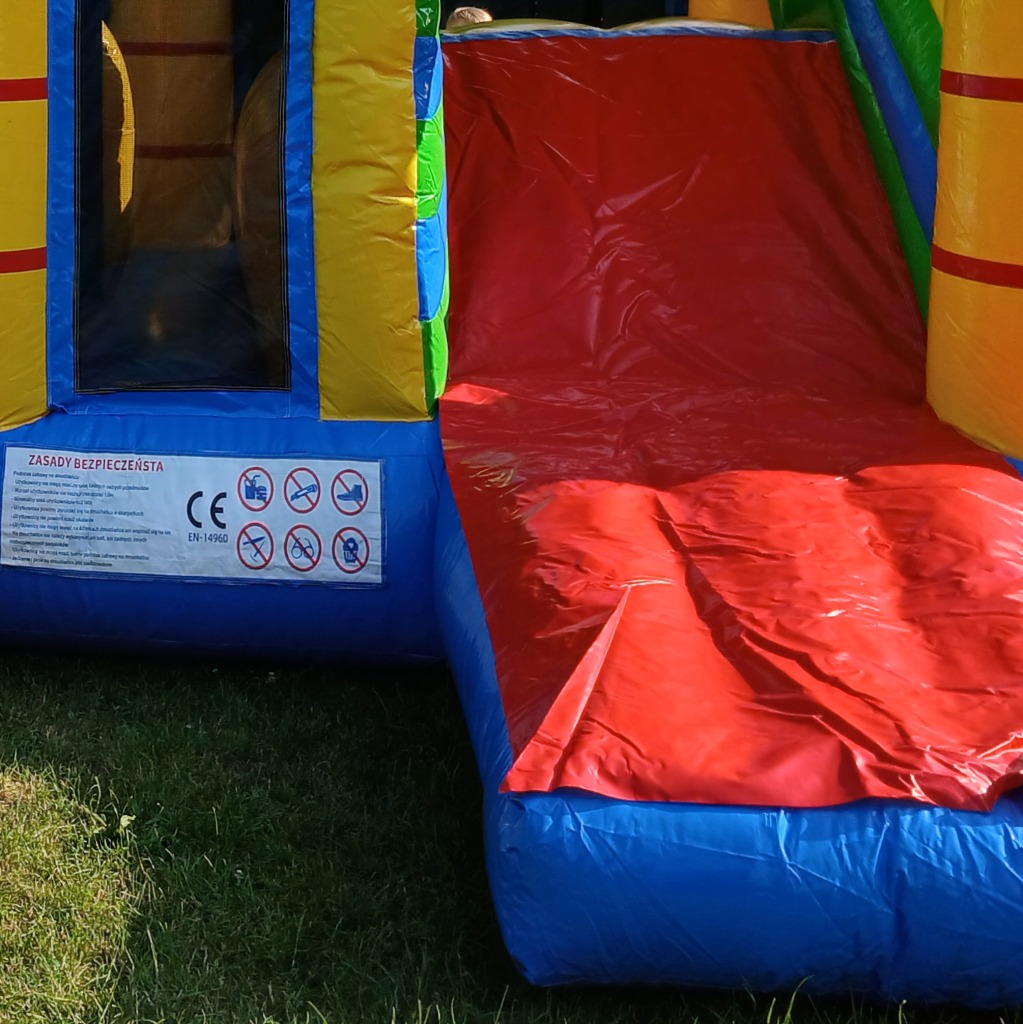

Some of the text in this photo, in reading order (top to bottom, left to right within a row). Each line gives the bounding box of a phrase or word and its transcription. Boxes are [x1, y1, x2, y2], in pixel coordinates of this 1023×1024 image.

[28, 454, 164, 473] ZASADY BEZPIECZEŃSTA
[186, 490, 227, 530] CE
[188, 532, 228, 543] EN-14960
